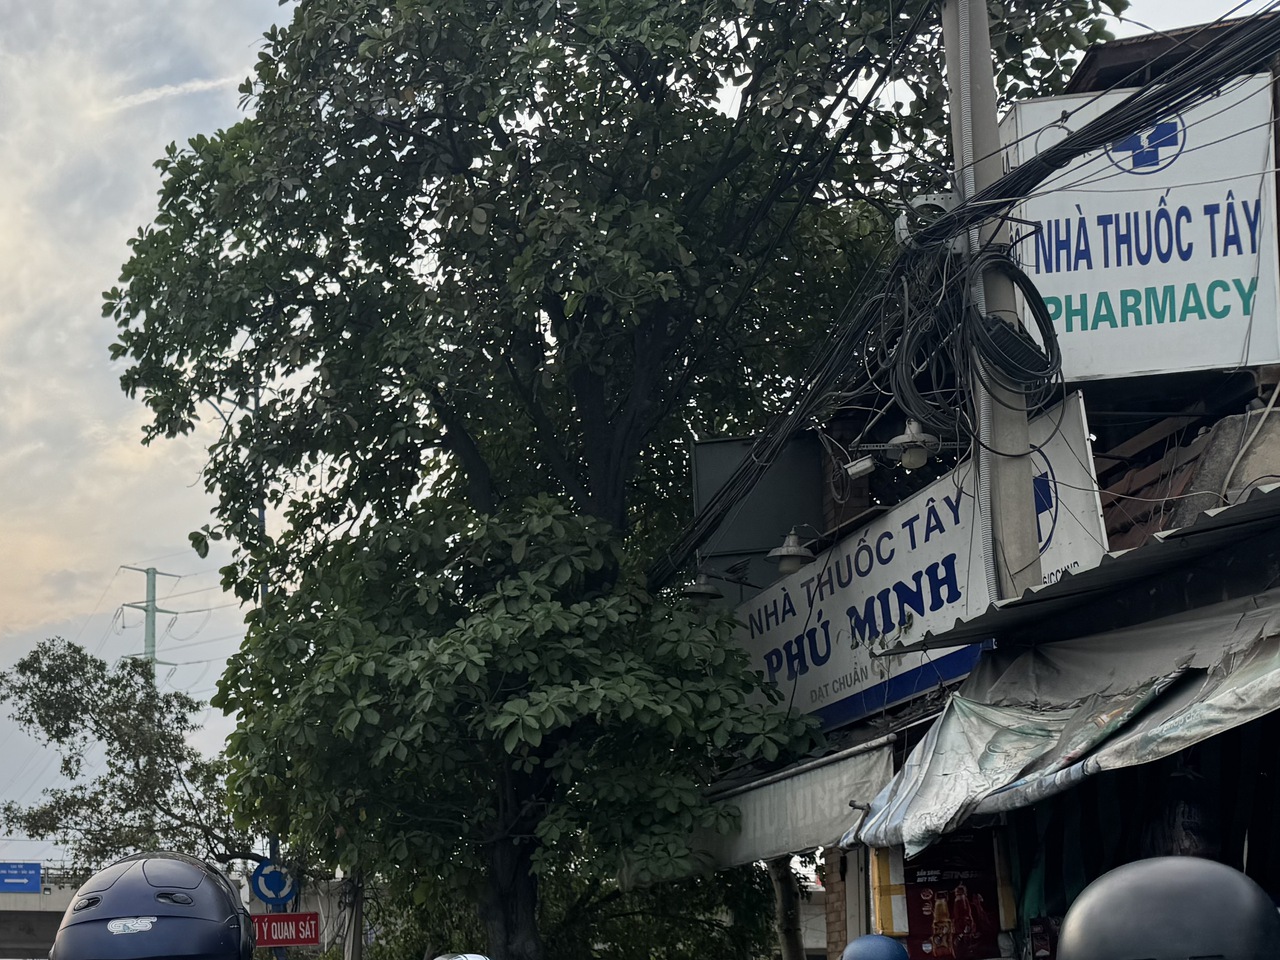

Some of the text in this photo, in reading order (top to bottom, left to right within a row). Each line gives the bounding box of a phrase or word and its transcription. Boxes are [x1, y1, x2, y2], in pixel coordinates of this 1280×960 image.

[1035, 204, 1093, 274] NHÀ
[1097, 188, 1193, 268] THUỐC
[1204, 190, 1261, 258] TÂY
[1041, 276, 1259, 332] PHARMACY
[748, 487, 964, 639] NHÀ THUỐC TÂY
[763, 553, 962, 682] PHÚ MINH
[810, 683, 829, 704] ĐẠT
[832, 662, 869, 694] CHUẨN
[262, 918, 268, 940] Ý
[271, 921, 296, 940] QUAN
[299, 916, 316, 939] SÁT
